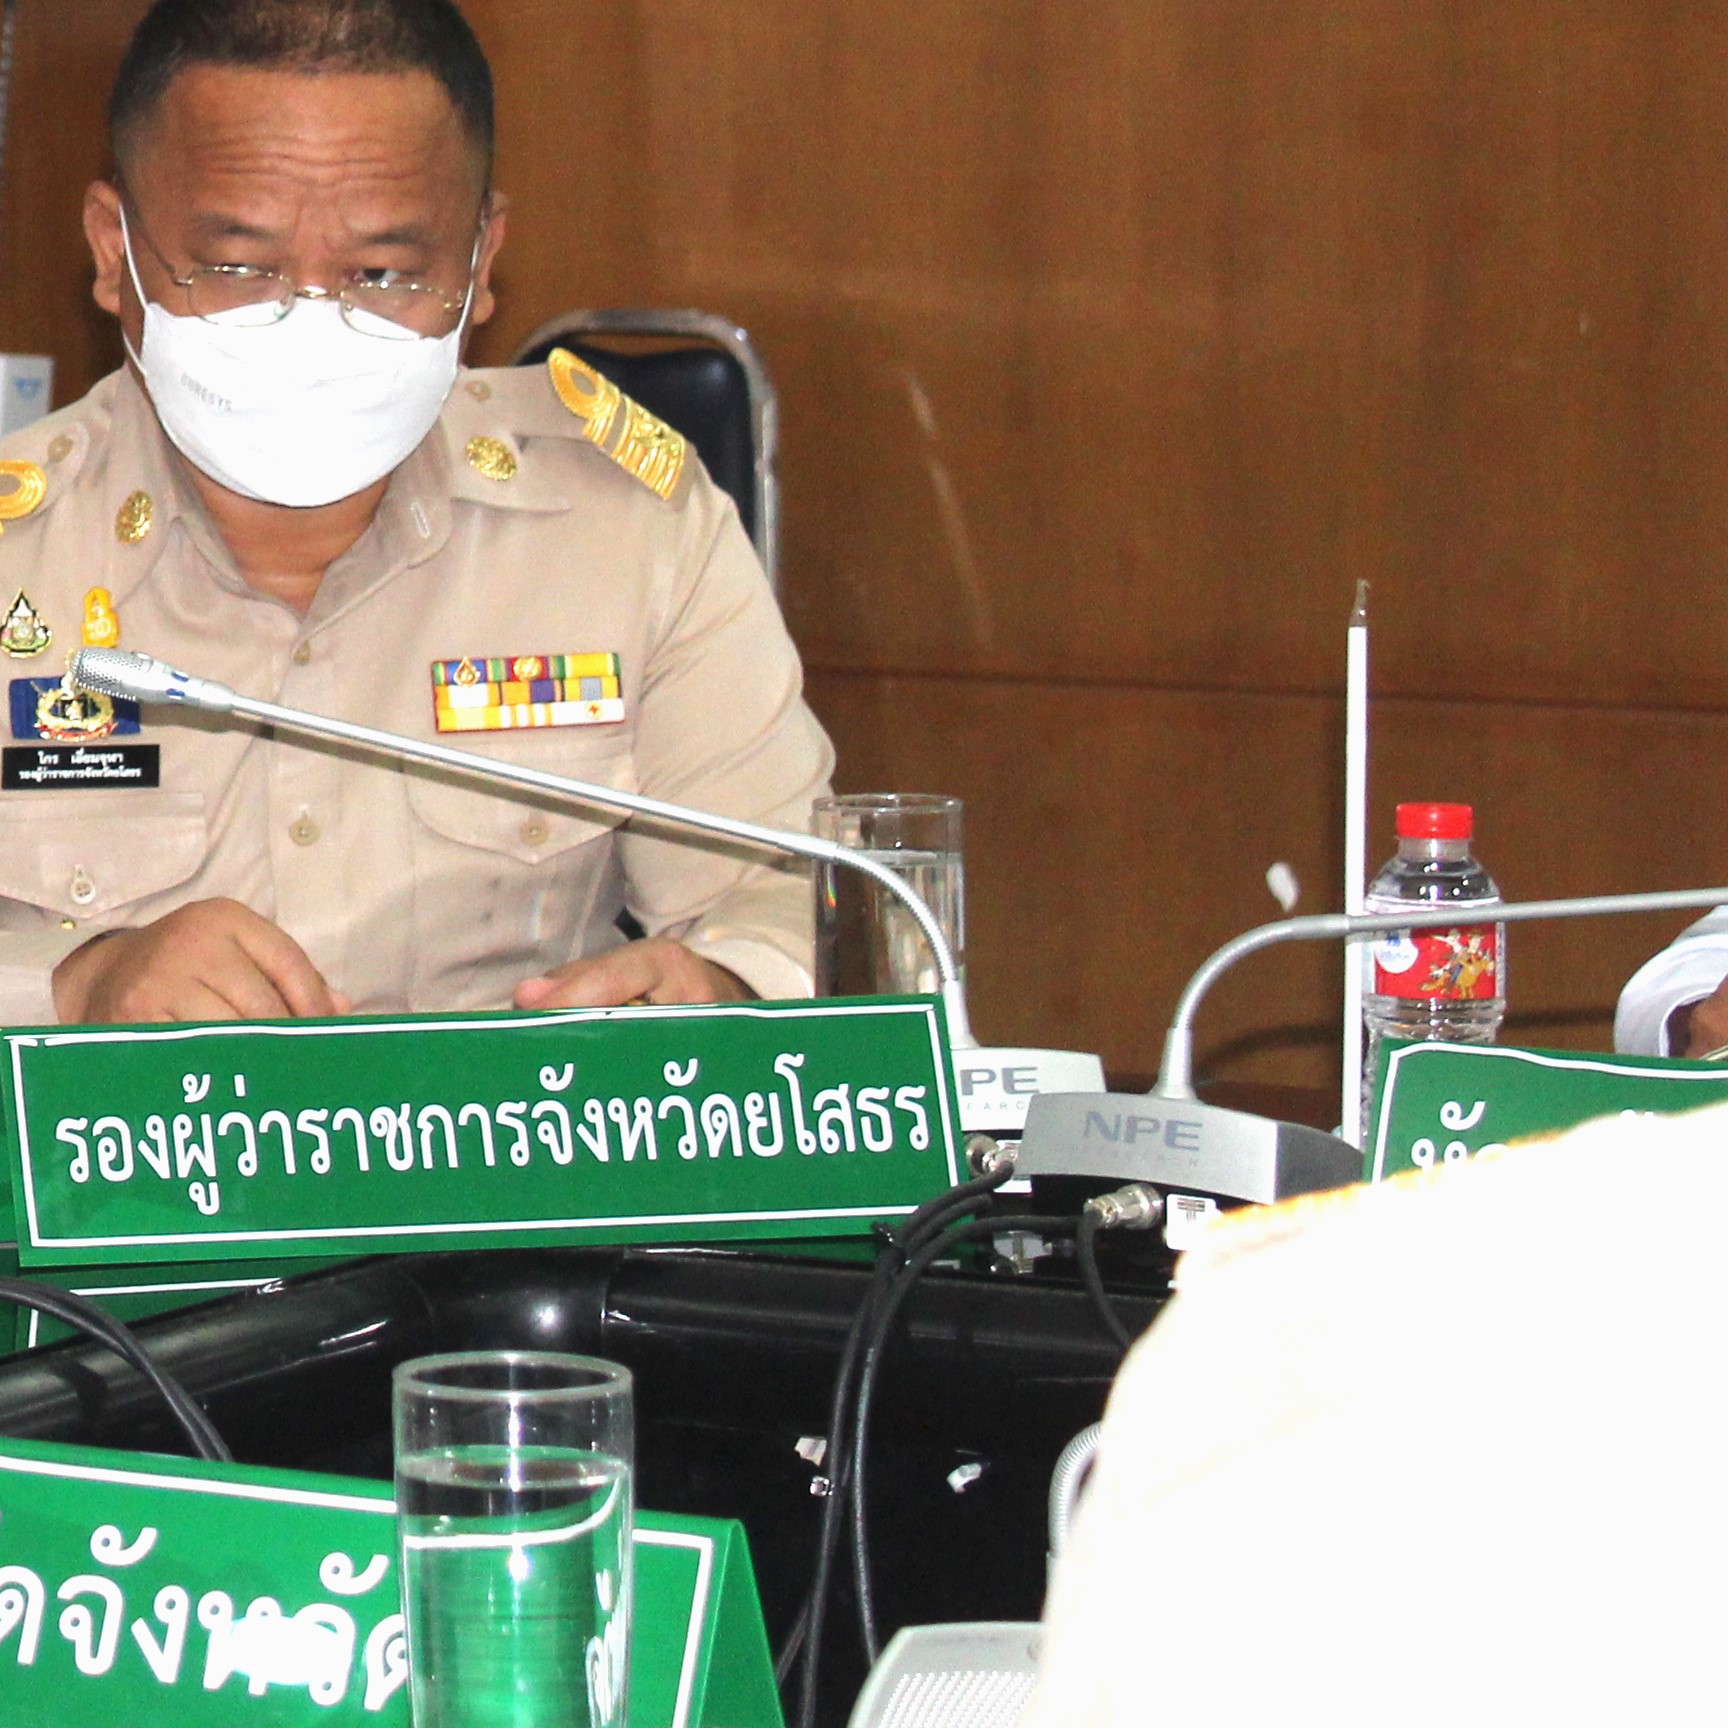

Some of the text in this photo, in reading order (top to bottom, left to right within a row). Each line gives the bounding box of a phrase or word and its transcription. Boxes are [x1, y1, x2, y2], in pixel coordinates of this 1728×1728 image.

[960, 1066, 1040, 1097] PE
[55, 1055, 932, 1216] รองผู้ว่าราชการจังหวัดยโสธร
[1082, 1110, 1204, 1153] NPE
